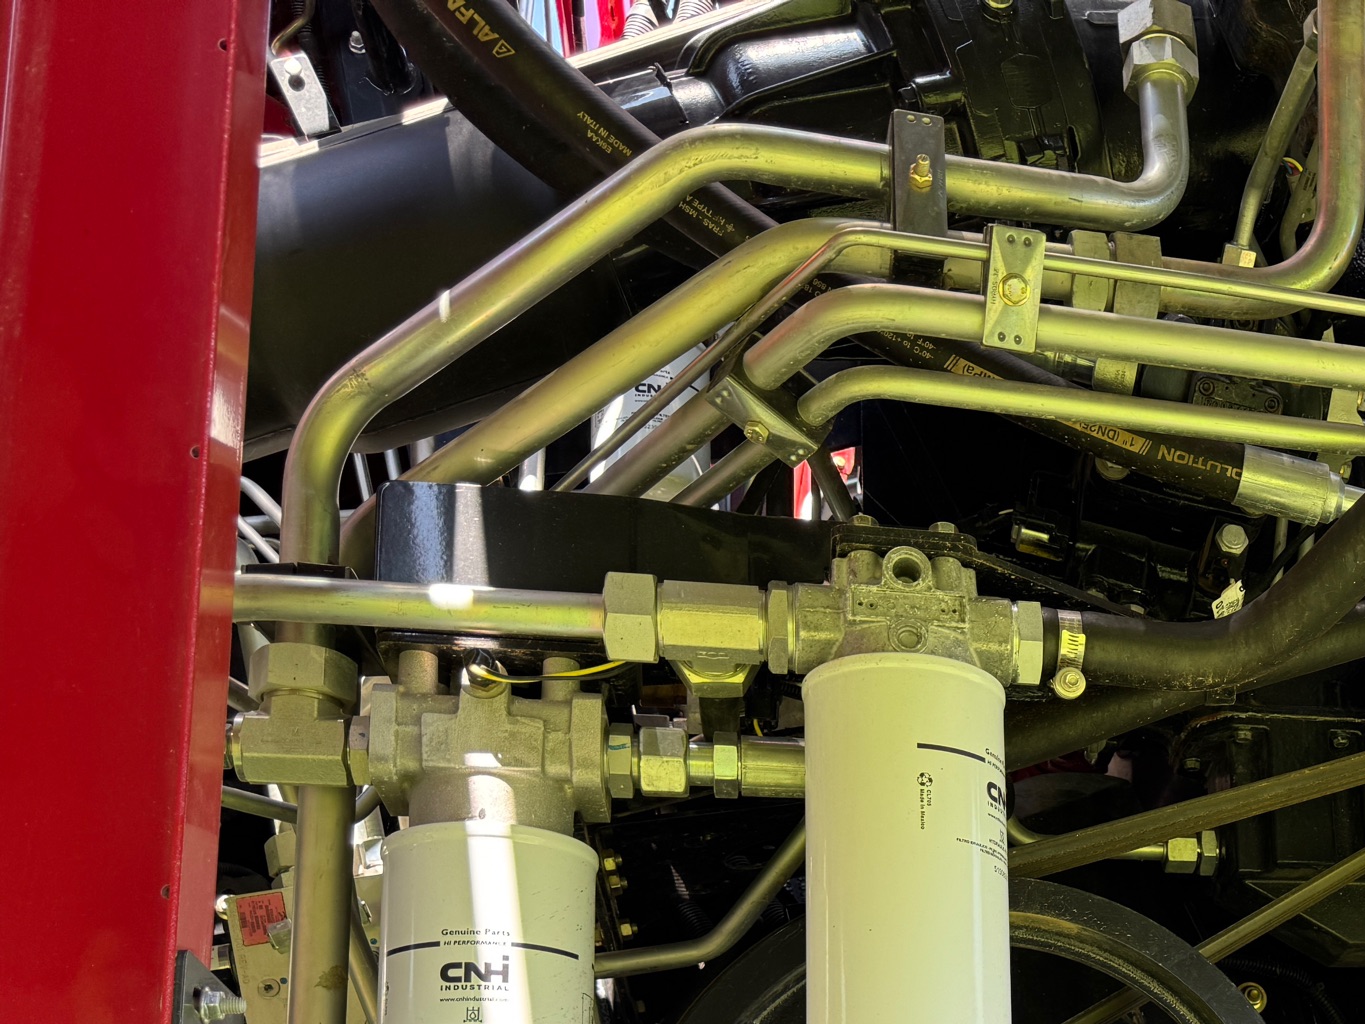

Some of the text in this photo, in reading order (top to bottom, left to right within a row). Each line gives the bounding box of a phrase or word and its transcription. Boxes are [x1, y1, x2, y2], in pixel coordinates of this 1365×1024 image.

[577, 111, 632, 157] MADE IN ITALY
[692, 198, 713, 218] TYPE
[441, 928, 481, 936] Genuine
[440, 984, 510, 992] INDUSTRIAL
